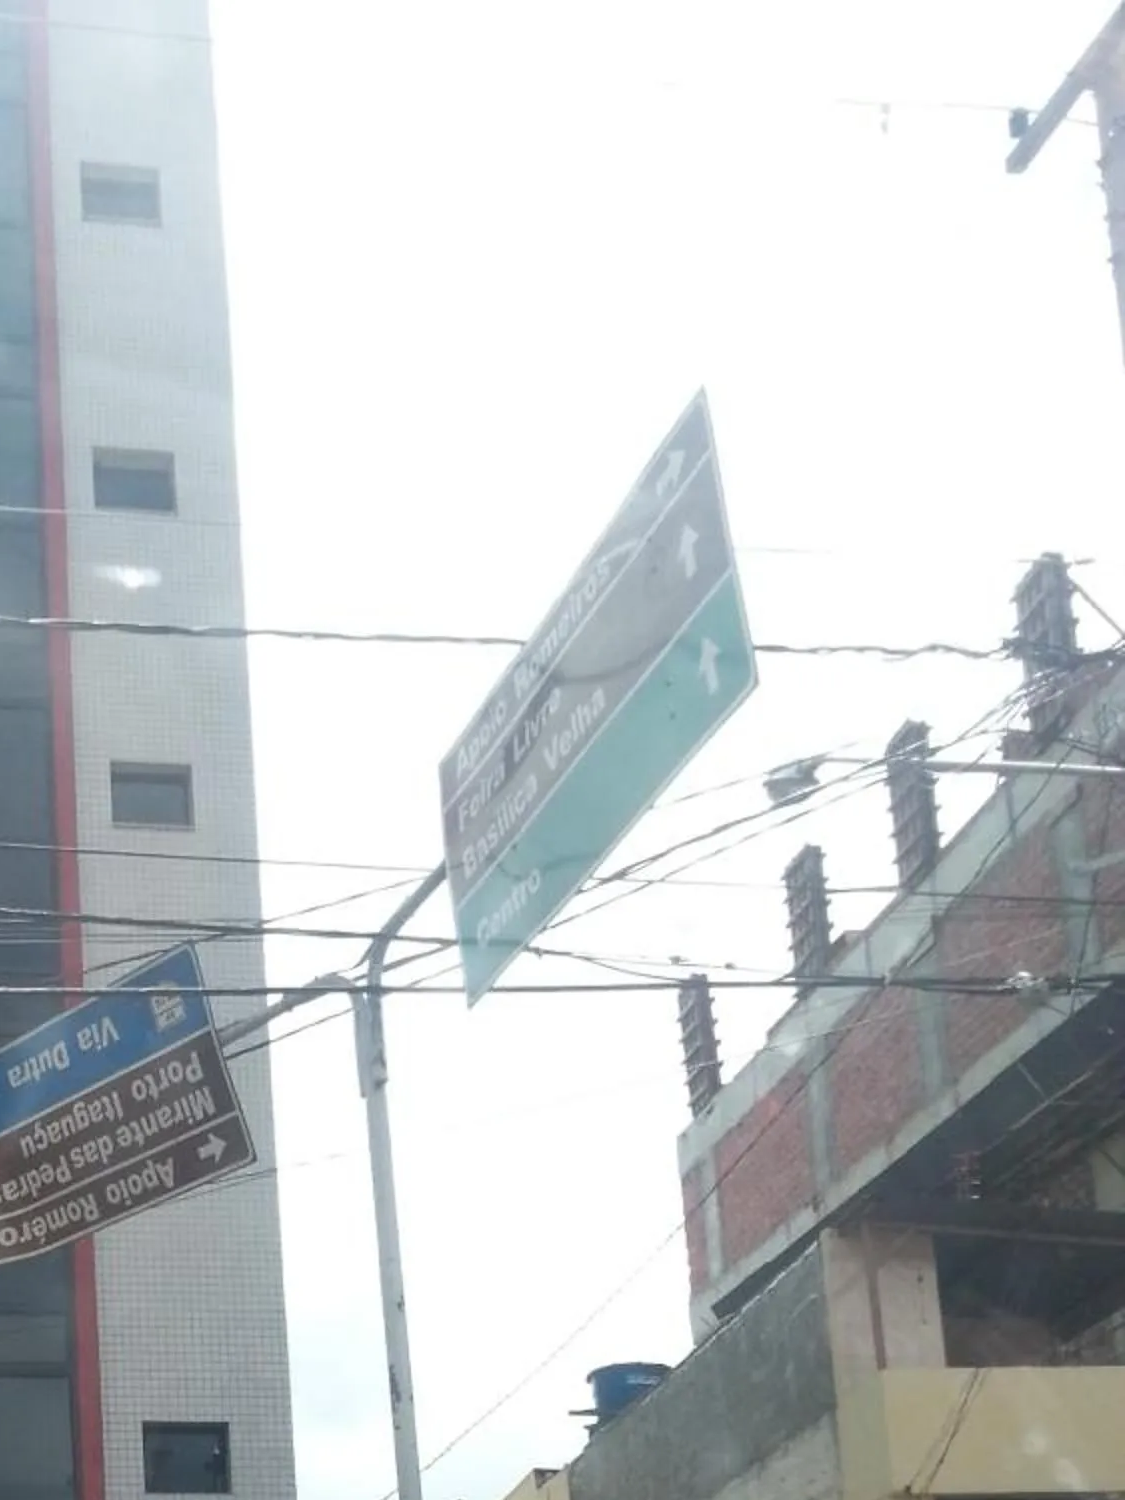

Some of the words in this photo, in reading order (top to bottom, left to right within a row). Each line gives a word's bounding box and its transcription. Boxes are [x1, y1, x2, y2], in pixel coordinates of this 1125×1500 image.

[457, 700, 507, 779] Apoio
[512, 555, 610, 700] Romeiros
[458, 760, 507, 833] Feira
[512, 686, 561, 762] Livre
[542, 686, 605, 771] Velha
[476, 868, 541, 949] Centro
[7, 1040, 71, 1089] Dutra
[76, 1016, 120, 1053] Via
[131, 1051, 205, 1101] Porto
[19, 1091, 124, 1156] Itaguaçu
[118, 1085, 218, 1148] Mirante
[70, 1132, 115, 1169] das
[106, 1157, 176, 1205] Apoio
